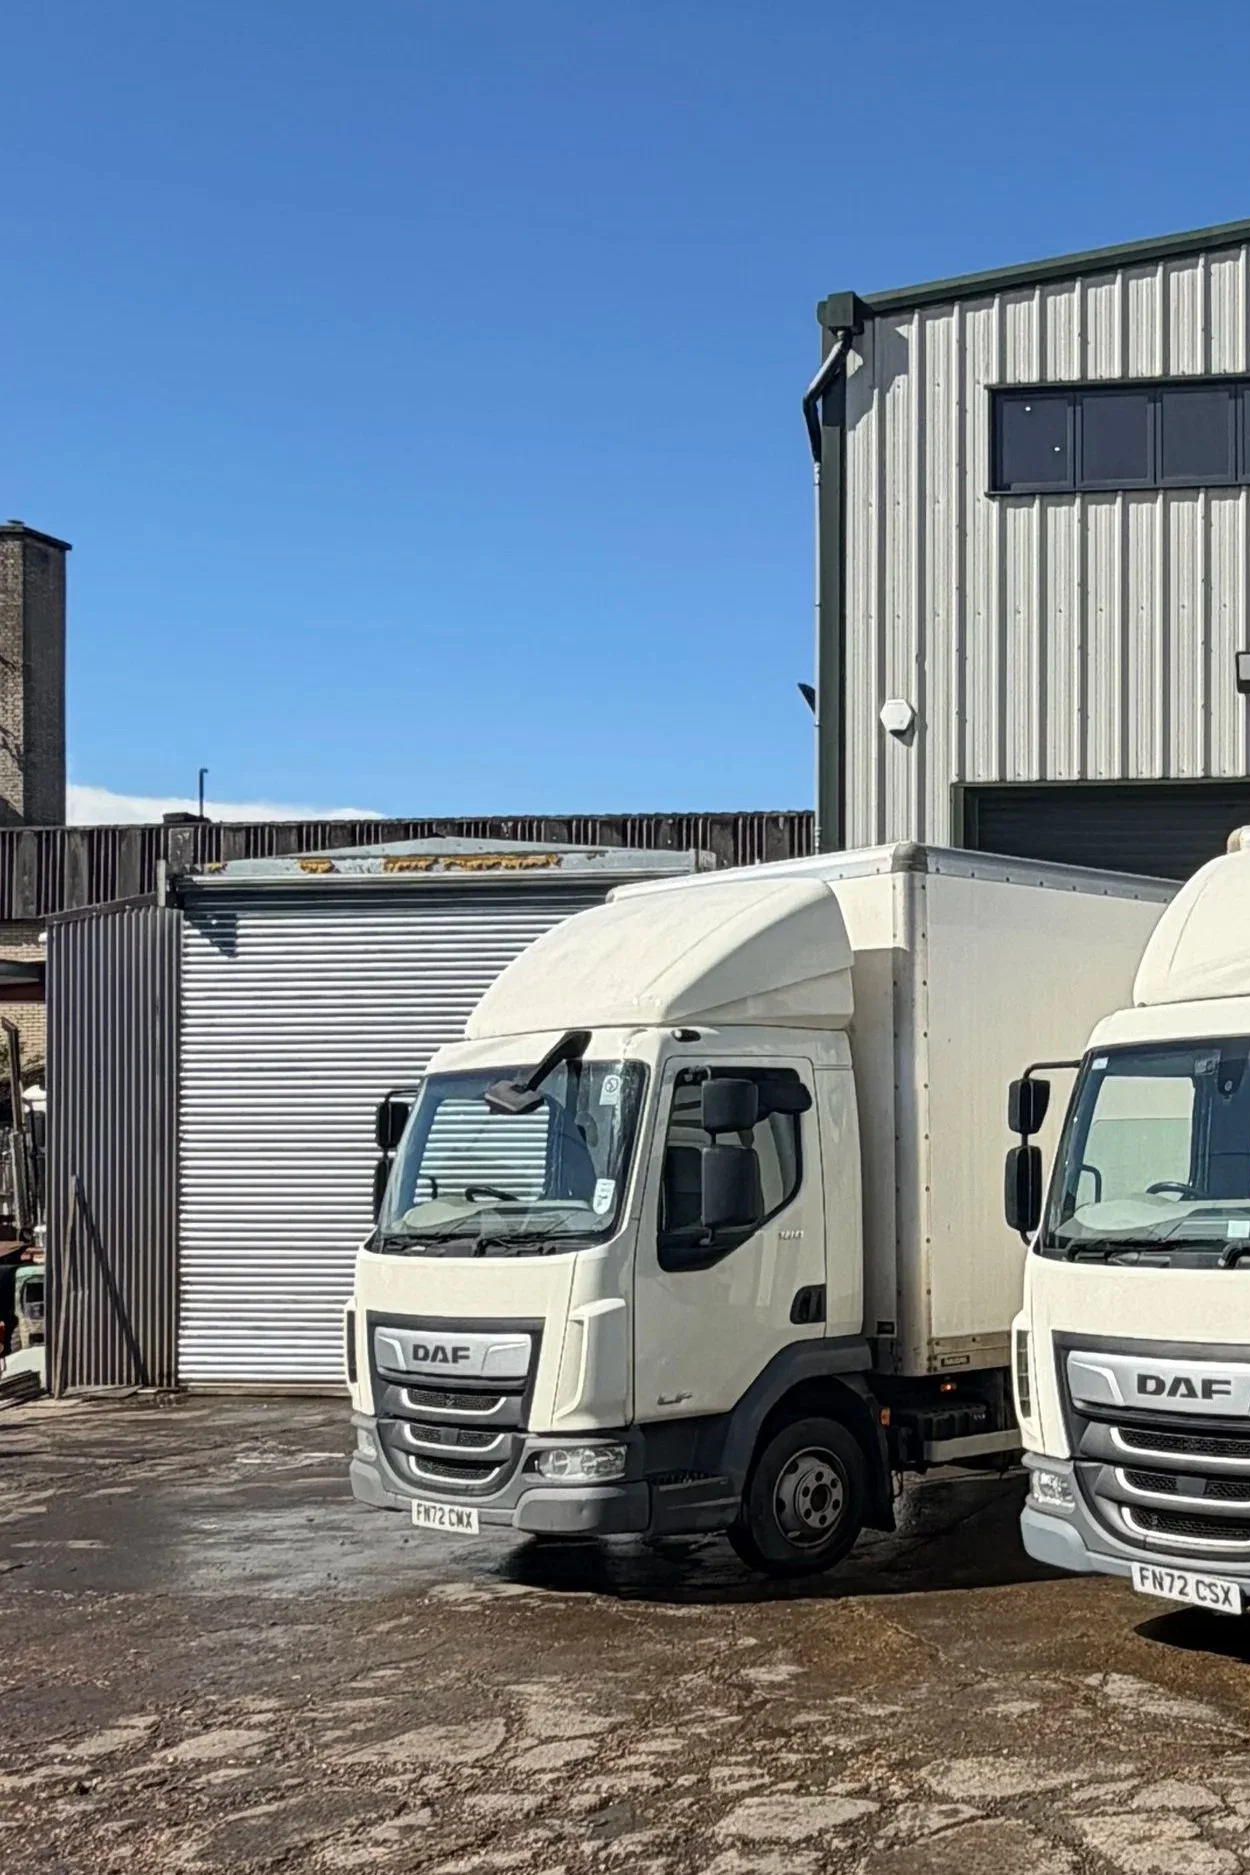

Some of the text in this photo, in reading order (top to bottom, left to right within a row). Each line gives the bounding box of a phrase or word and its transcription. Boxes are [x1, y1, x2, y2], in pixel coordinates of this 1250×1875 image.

[412, 1343, 471, 1364] DAF
[1137, 1373, 1232, 1400] DAF
[416, 1502, 446, 1526] FN72
[1139, 1566, 1233, 1608] FN72 CSX
